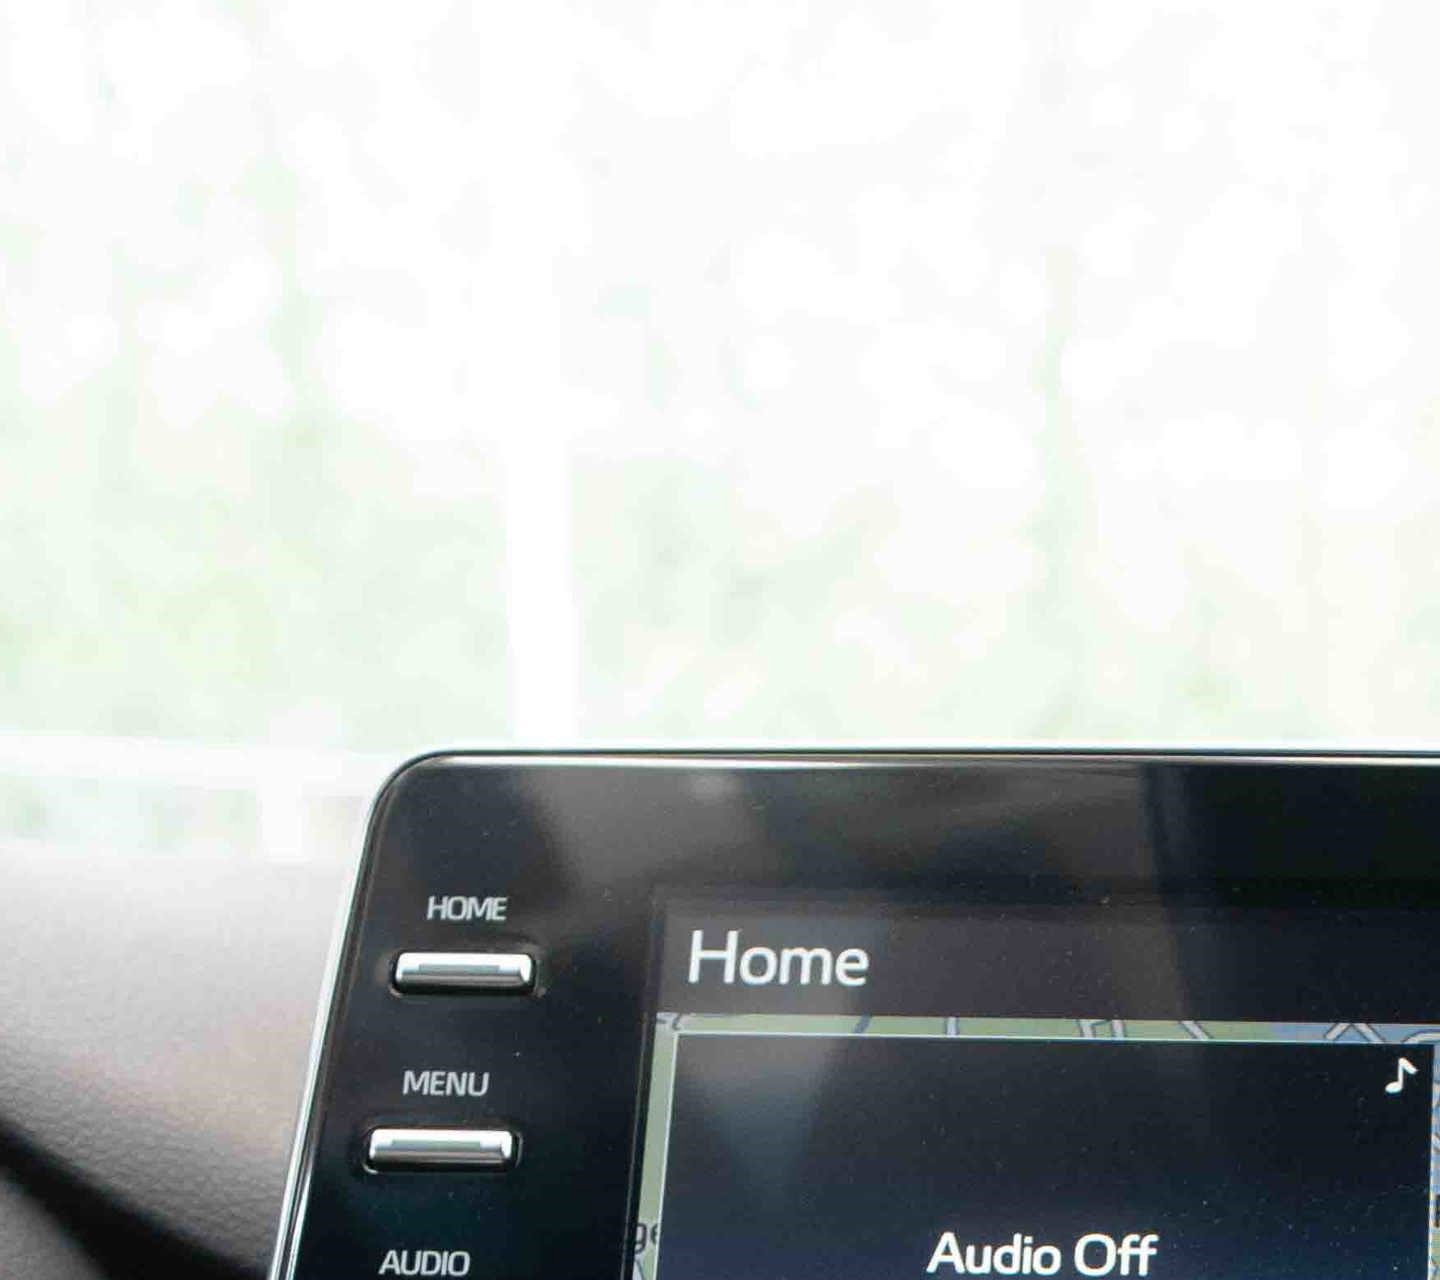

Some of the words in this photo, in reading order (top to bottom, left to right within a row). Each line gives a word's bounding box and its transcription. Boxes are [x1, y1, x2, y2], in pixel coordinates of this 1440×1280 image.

[427, 896, 507, 921] HOME
[687, 930, 869, 987] Home
[403, 1070, 489, 1096] MENU
[379, 1250, 470, 1276] AUDIO
[927, 1232, 1061, 1277] Audio
[1074, 1234, 1159, 1277] Off
